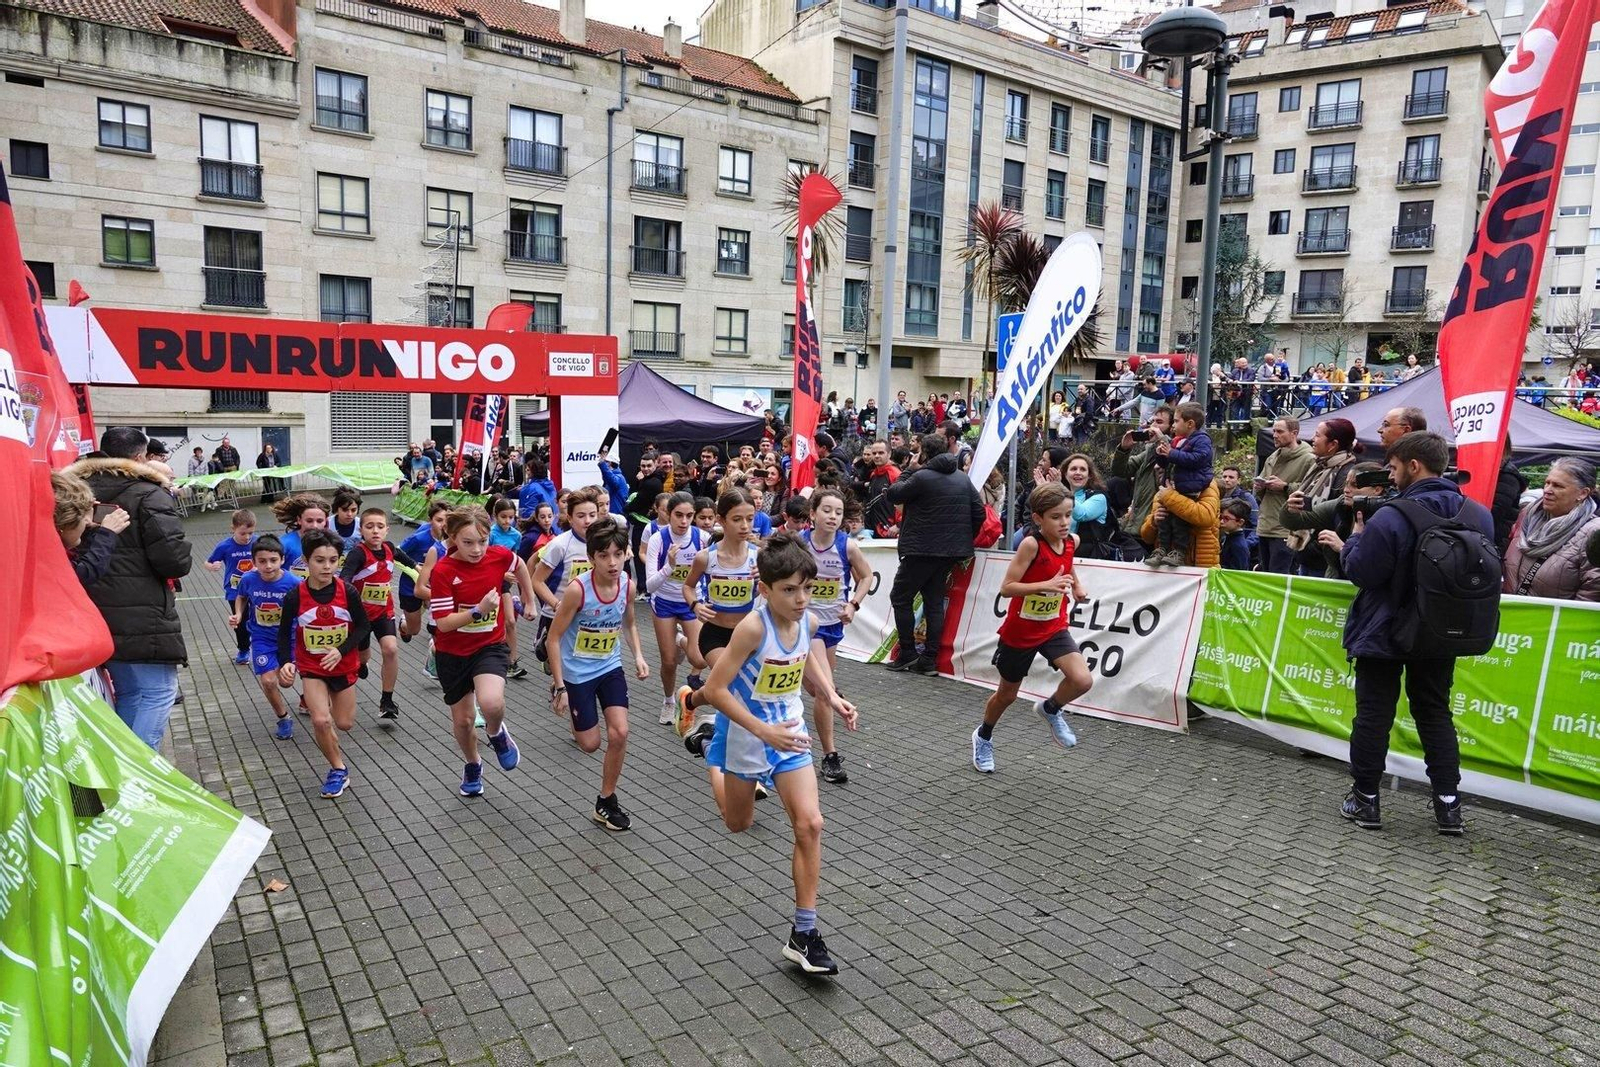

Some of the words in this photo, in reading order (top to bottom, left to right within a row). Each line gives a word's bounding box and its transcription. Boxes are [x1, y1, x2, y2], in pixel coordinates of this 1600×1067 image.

[552, 357, 591, 365] CONCELLO
[996, 285, 1086, 442] Atlántico
[557, 364, 567, 372] DE
[569, 364, 586, 372] VIGO
[566, 451, 600, 463] Atlán
[368, 590, 389, 599] 121
[715, 585, 747, 597] 1205
[811, 585, 835, 596] 223
[1031, 600, 1058, 612] 1208
[1239, 597, 1274, 616] auga
[260, 613, 281, 622] 123
[1296, 603, 1334, 623] máis
[1335, 607, 1347, 628] que
[309, 634, 342, 645] 1233
[584, 637, 616, 649] 1217
[1495, 631, 1533, 654] uga
[1566, 638, 1600, 660] má
[1226, 651, 1262, 673] auga
[1503, 657, 1512, 667] ti
[768, 668, 801, 688] 1232
[1283, 662, 1322, 684] máis
[1322, 667, 1335, 689] que
[1453, 692, 1467, 716] que
[1469, 698, 1519, 724] auga
